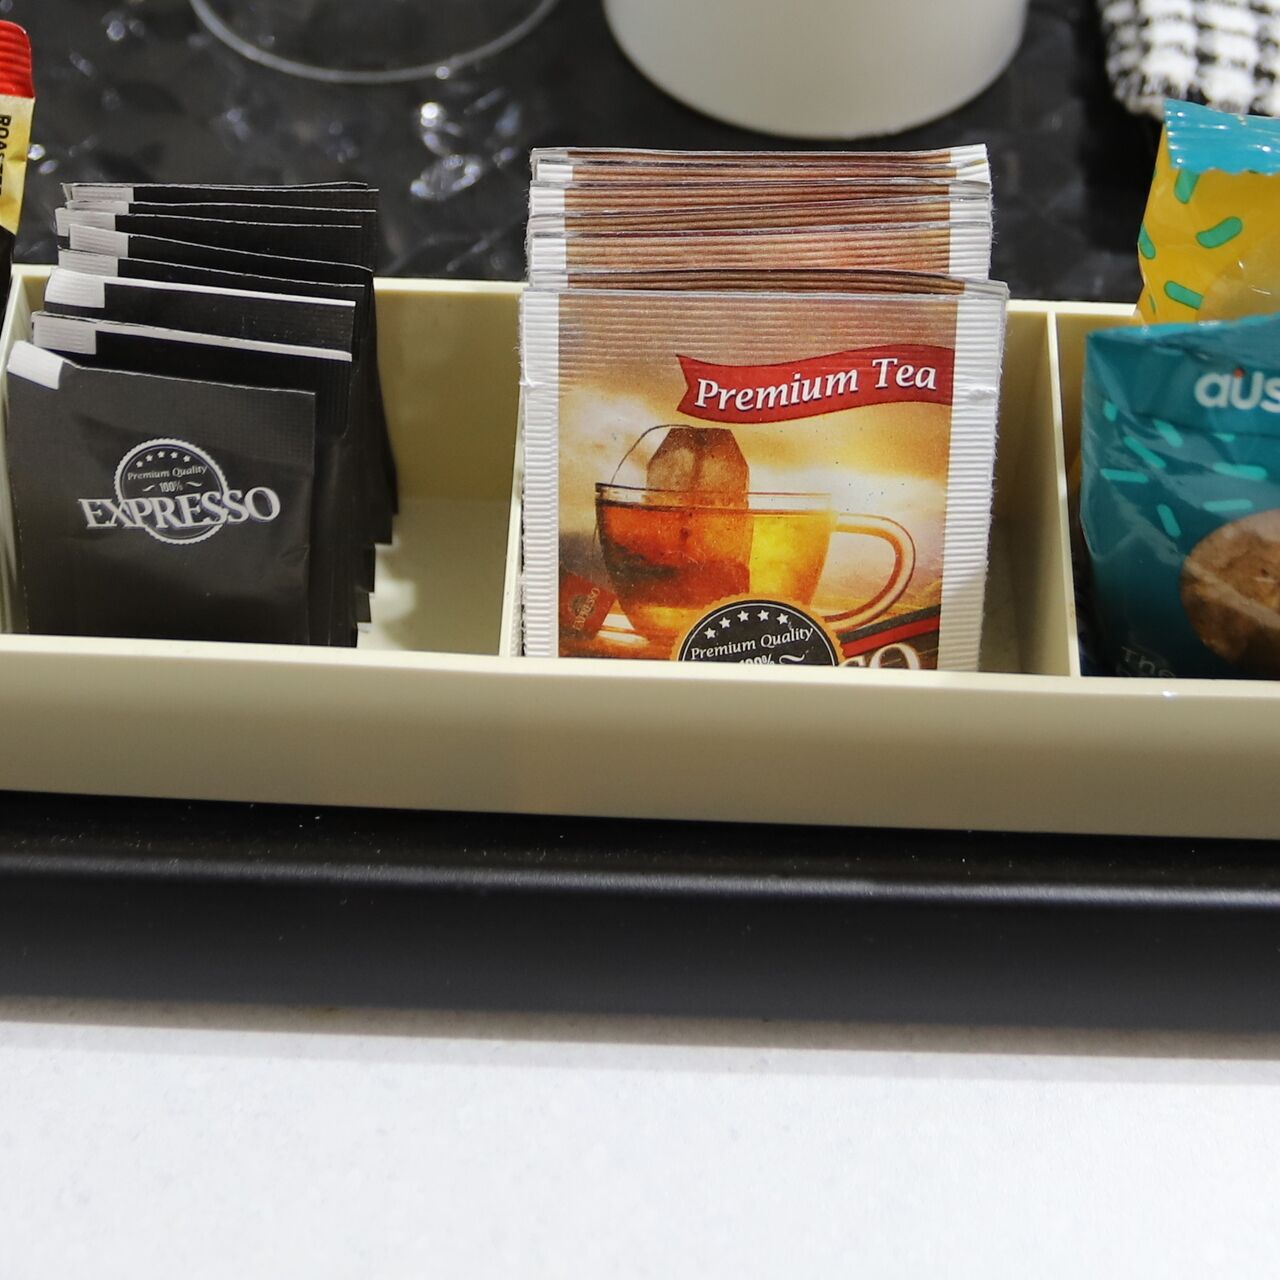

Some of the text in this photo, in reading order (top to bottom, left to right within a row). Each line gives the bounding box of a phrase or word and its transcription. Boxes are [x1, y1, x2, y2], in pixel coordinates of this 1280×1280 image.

[695, 357, 938, 411] Premium Tea
[127, 464, 208, 481] Premium Quality
[159, 481, 184, 493] 100%
[78, 486, 281, 529] EXPRESSO
[691, 640, 756, 660] Premium
[760, 627, 814, 649] Quality
